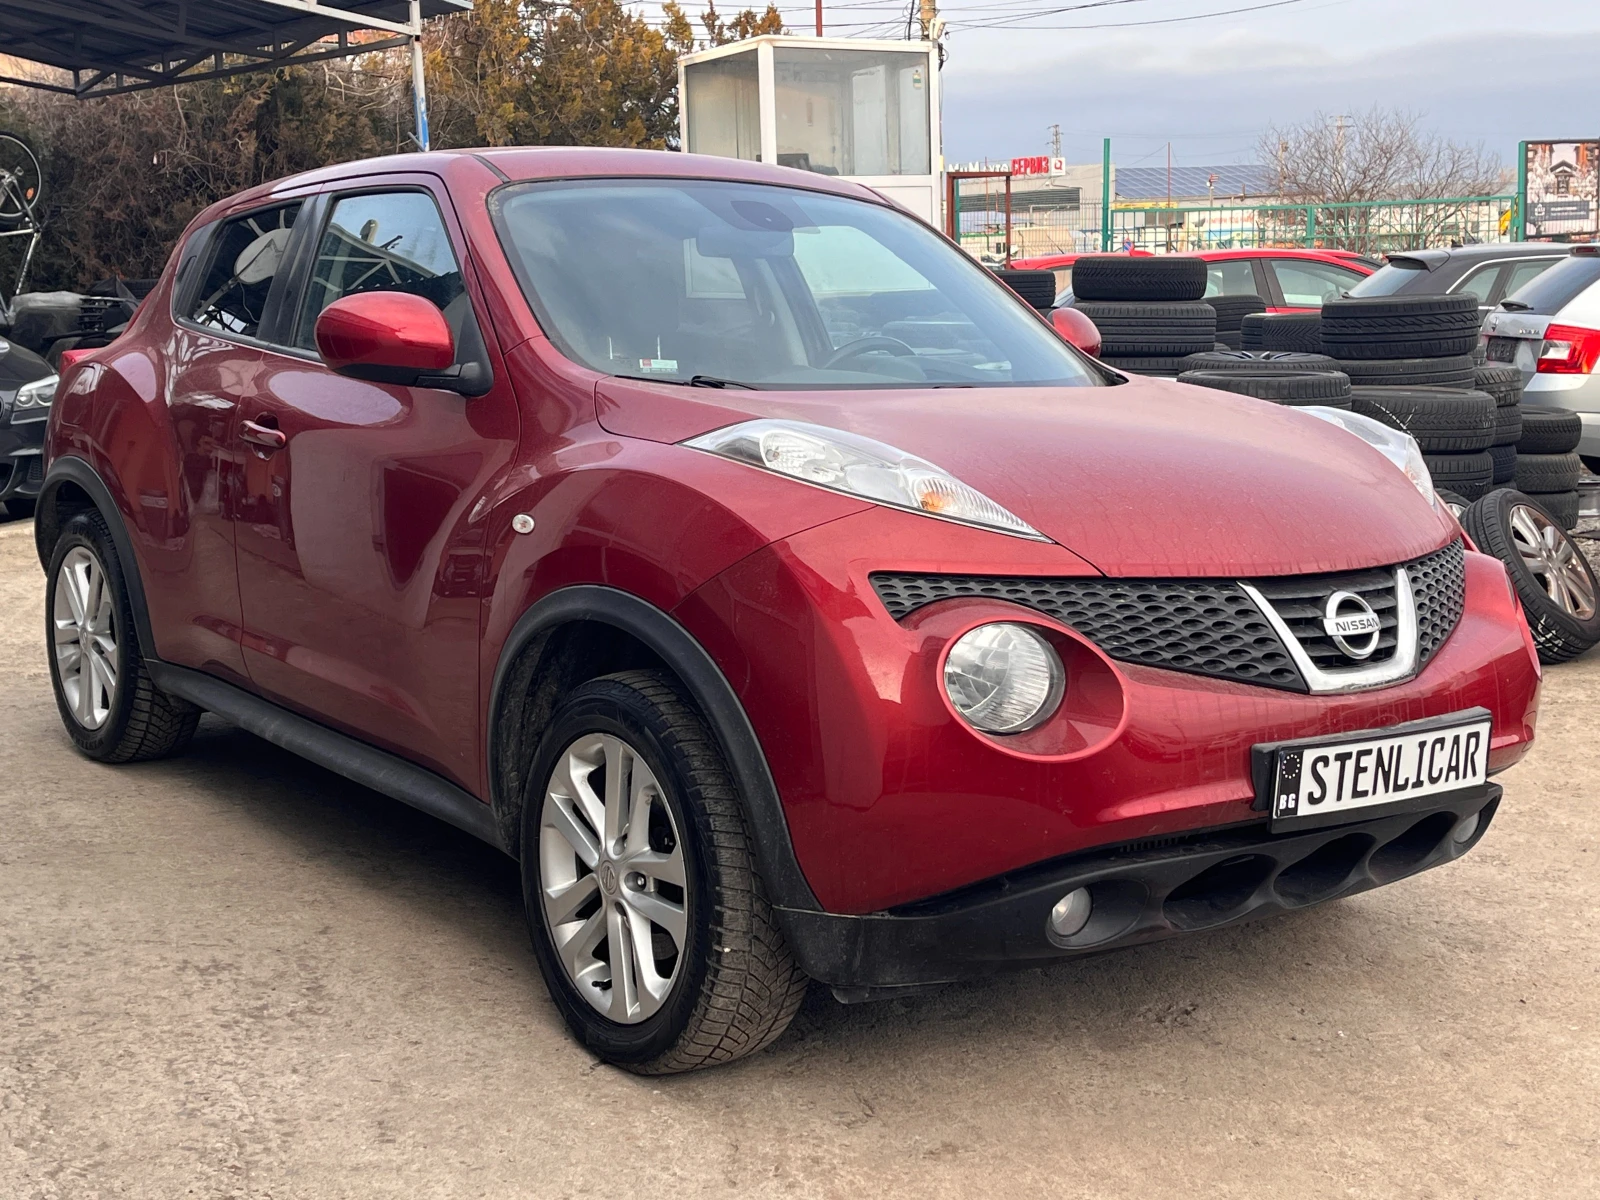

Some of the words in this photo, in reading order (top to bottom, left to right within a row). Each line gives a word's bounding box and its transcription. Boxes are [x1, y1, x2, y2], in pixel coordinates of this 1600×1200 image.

[1011, 156, 1050, 176] СЕРВИЗ
[1334, 617, 1379, 632] NISSAN
[1307, 730, 1481, 806] STENLICAR
[1278, 793, 1296, 810] BG
